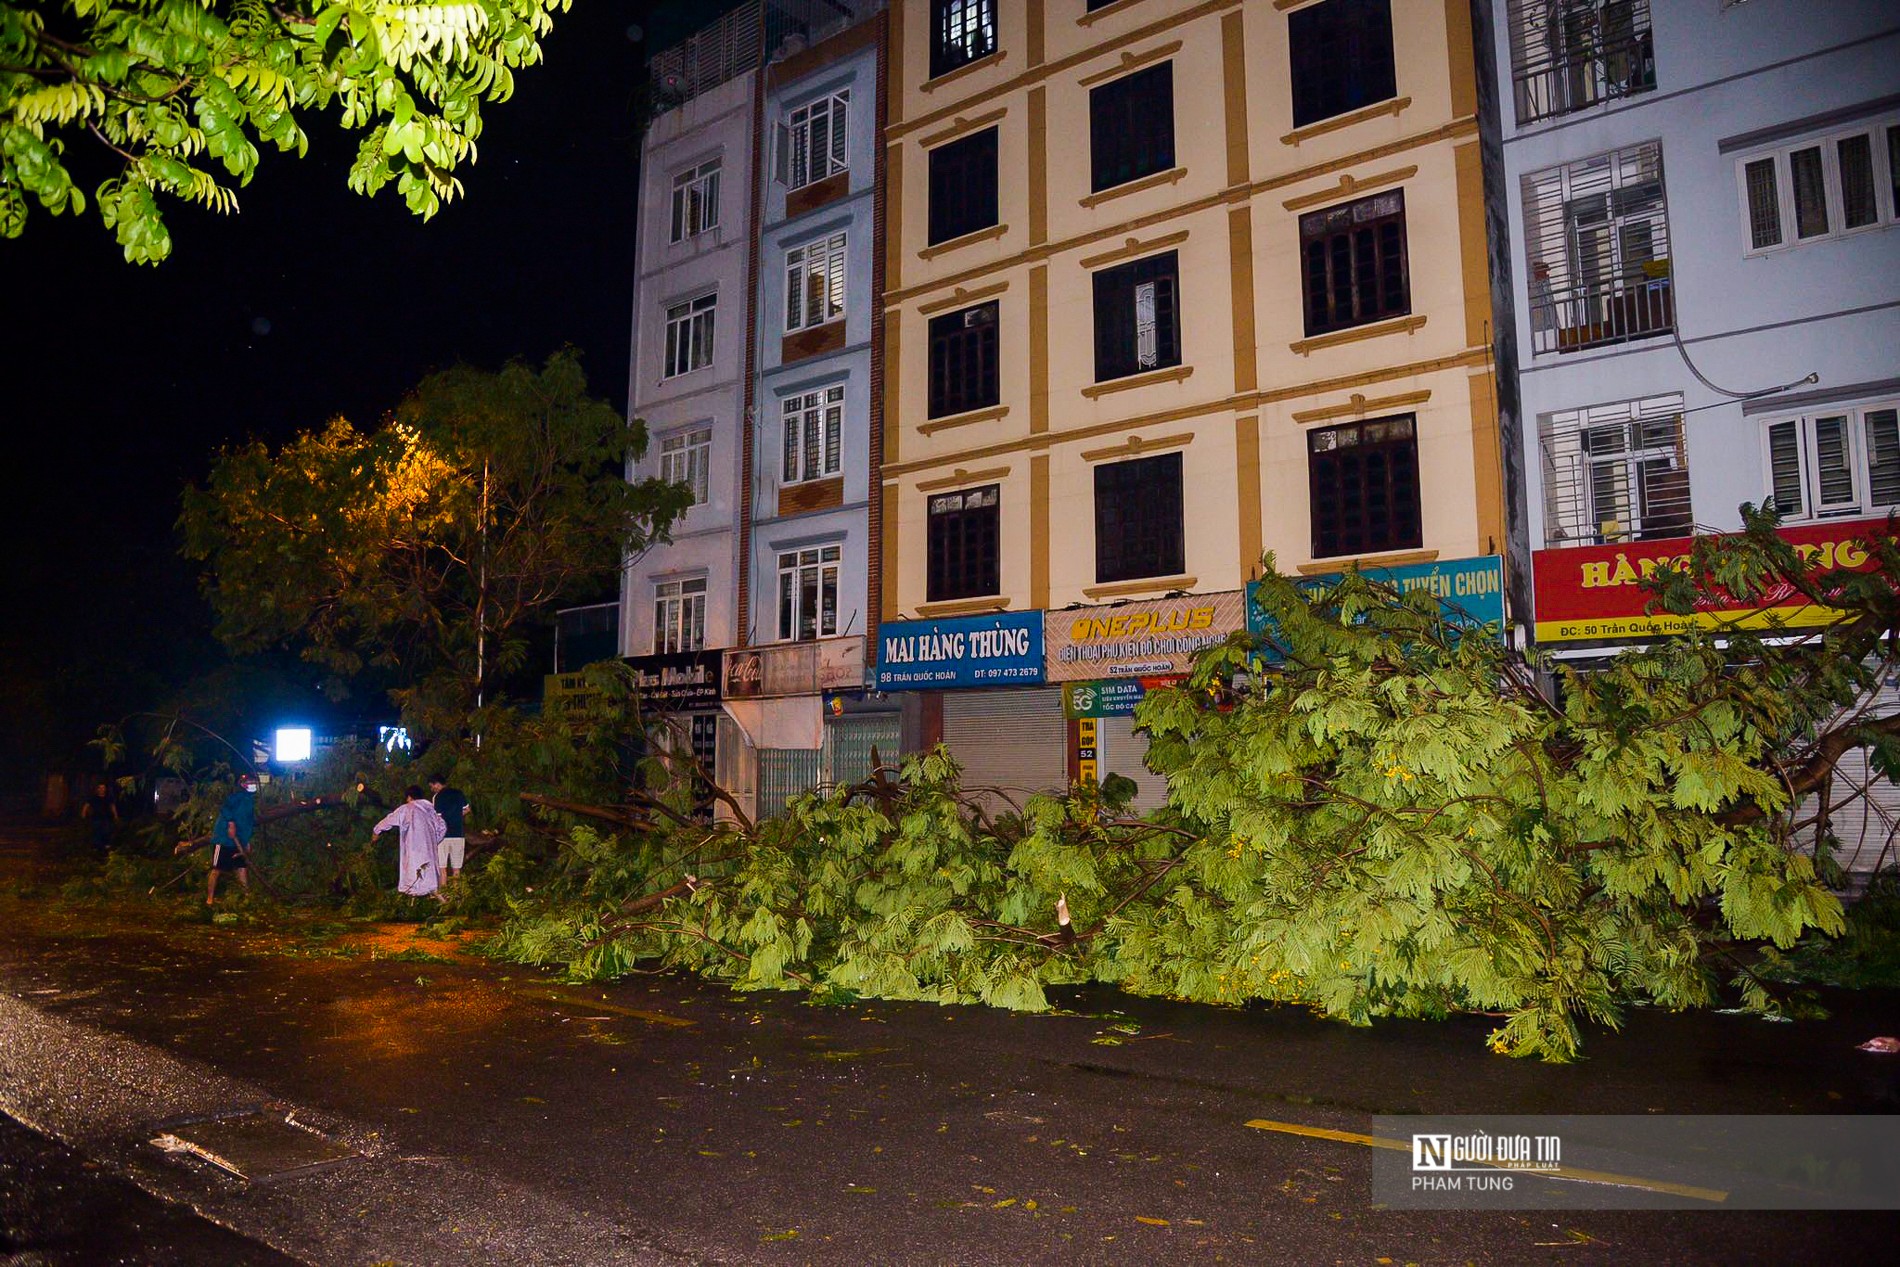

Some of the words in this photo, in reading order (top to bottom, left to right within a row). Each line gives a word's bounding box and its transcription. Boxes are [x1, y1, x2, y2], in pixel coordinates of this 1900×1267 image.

[1455, 568, 1500, 600] CHỌN
[1071, 606, 1216, 639] ONEPLUS
[1560, 626, 1581, 637] ĐC:
[1584, 625, 1597, 636] 50
[1600, 622, 1626, 635] Trần
[1629, 620, 1660, 636] Quốc
[1664, 620, 1694, 631] Hoà
[885, 637, 914, 664] MAI
[918, 626, 965, 662] HÀNG
[968, 621, 1030, 659] THÙNG
[661, 663, 715, 687] Mobile
[880, 671, 892, 683] 98
[913, 668, 934, 681] QUỐC
[988, 668, 1002, 678] 097
[1003, 667, 1018, 677] 473
[1019, 666, 1038, 677] 2679
[1109, 666, 1118, 674] 52
[1100, 685, 1116, 695] SIM
[1117, 684, 1138, 694] DATA
[1072, 694, 1093, 711] 5G
[1080, 750, 1093, 758] 52
